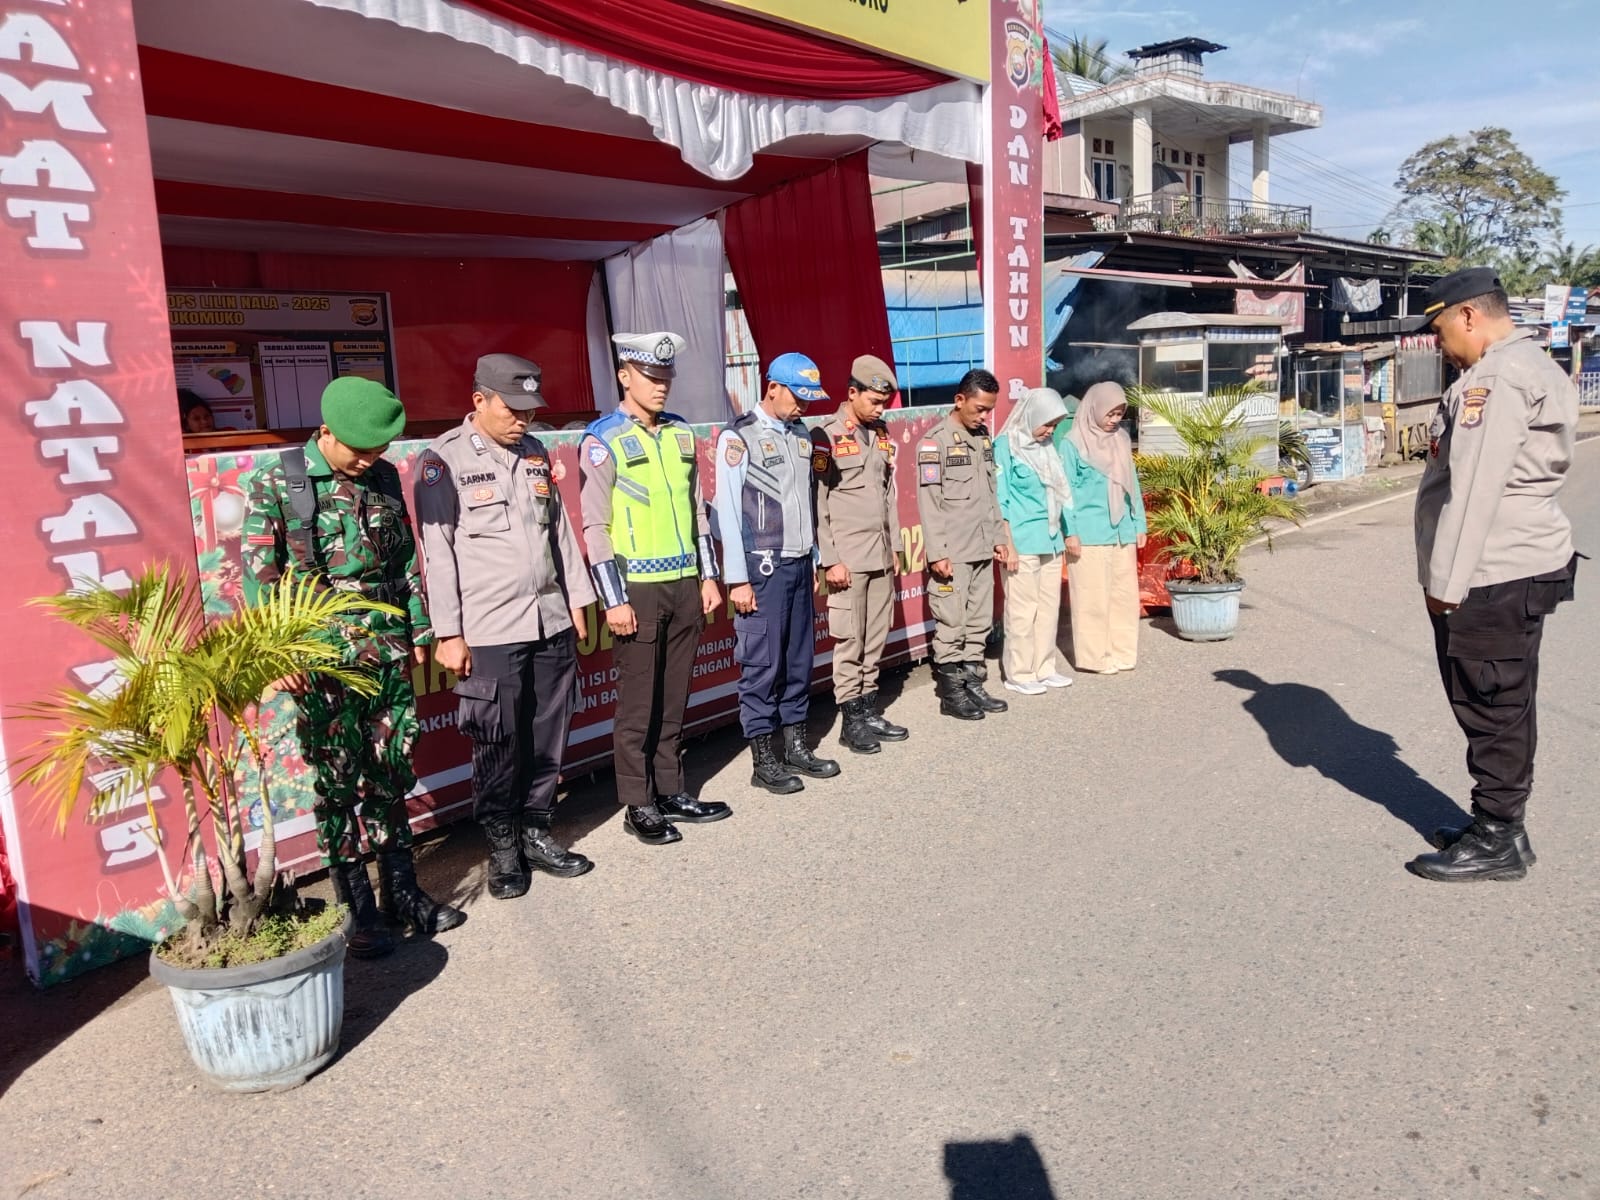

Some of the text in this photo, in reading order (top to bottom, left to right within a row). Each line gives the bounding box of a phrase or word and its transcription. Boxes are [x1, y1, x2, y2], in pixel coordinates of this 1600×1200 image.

[0, 0, 107, 250] AMAT
[1007, 105, 1030, 186] DAN
[200, 295, 238, 310] LILIN
[240, 296, 279, 310] NALA
[292, 297, 331, 311] 2025
[1007, 216, 1030, 348] TAHUN
[19, 320, 139, 598] NATAL
[696, 636, 735, 657] MBIAR
